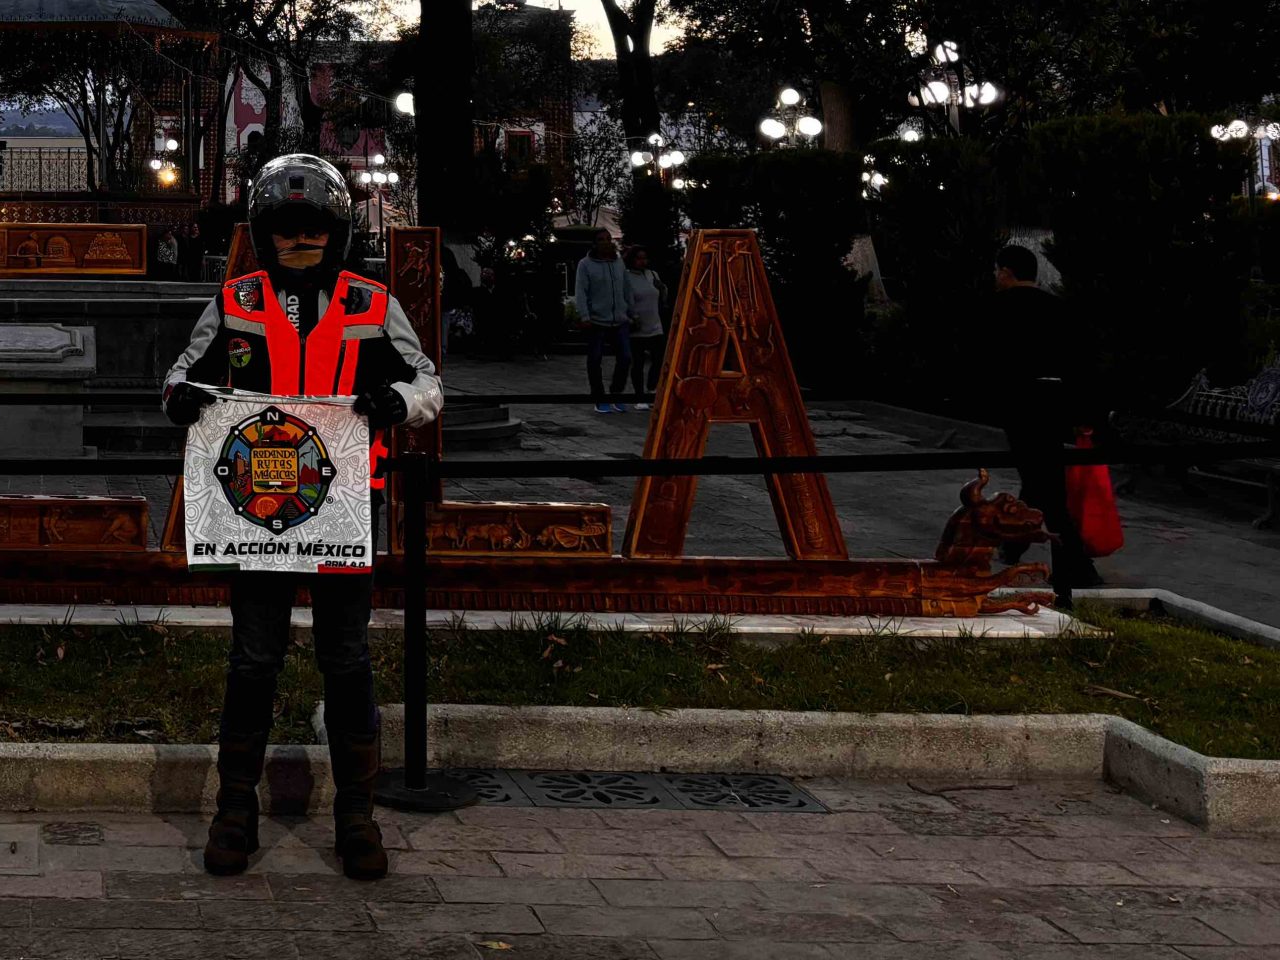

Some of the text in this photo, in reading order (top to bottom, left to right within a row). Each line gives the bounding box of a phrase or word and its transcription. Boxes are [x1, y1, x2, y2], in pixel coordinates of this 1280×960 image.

[266, 412, 279, 421] N
[217, 467, 229, 475] O
[322, 467, 332, 476] E
[272, 520, 283, 528] S
[193, 537, 366, 557] EN ACCIÓN MÉXICO
